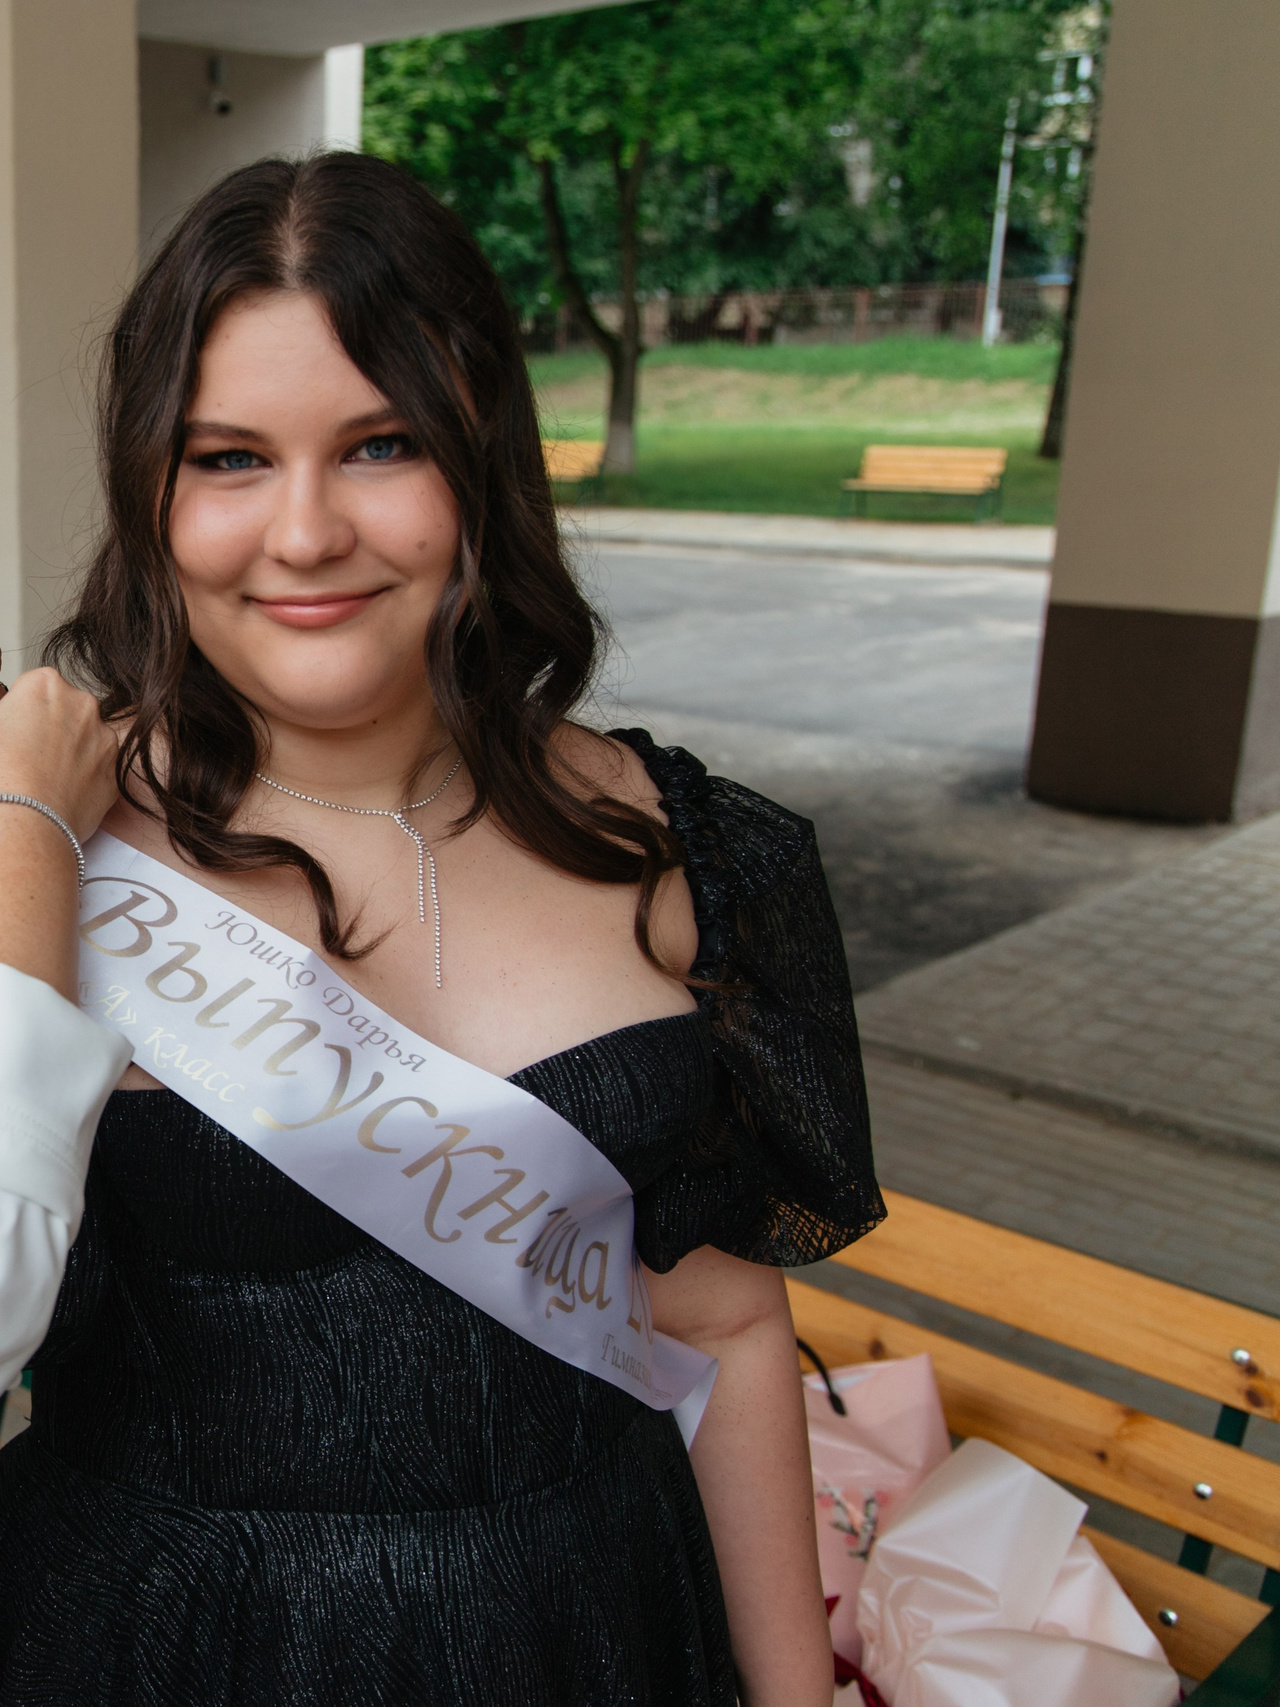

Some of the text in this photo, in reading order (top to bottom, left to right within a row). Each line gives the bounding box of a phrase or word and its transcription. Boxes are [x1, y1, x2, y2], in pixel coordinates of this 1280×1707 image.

[78, 876, 613, 1320] Выпускница
[204, 910, 427, 1073] Юшко Дарья
